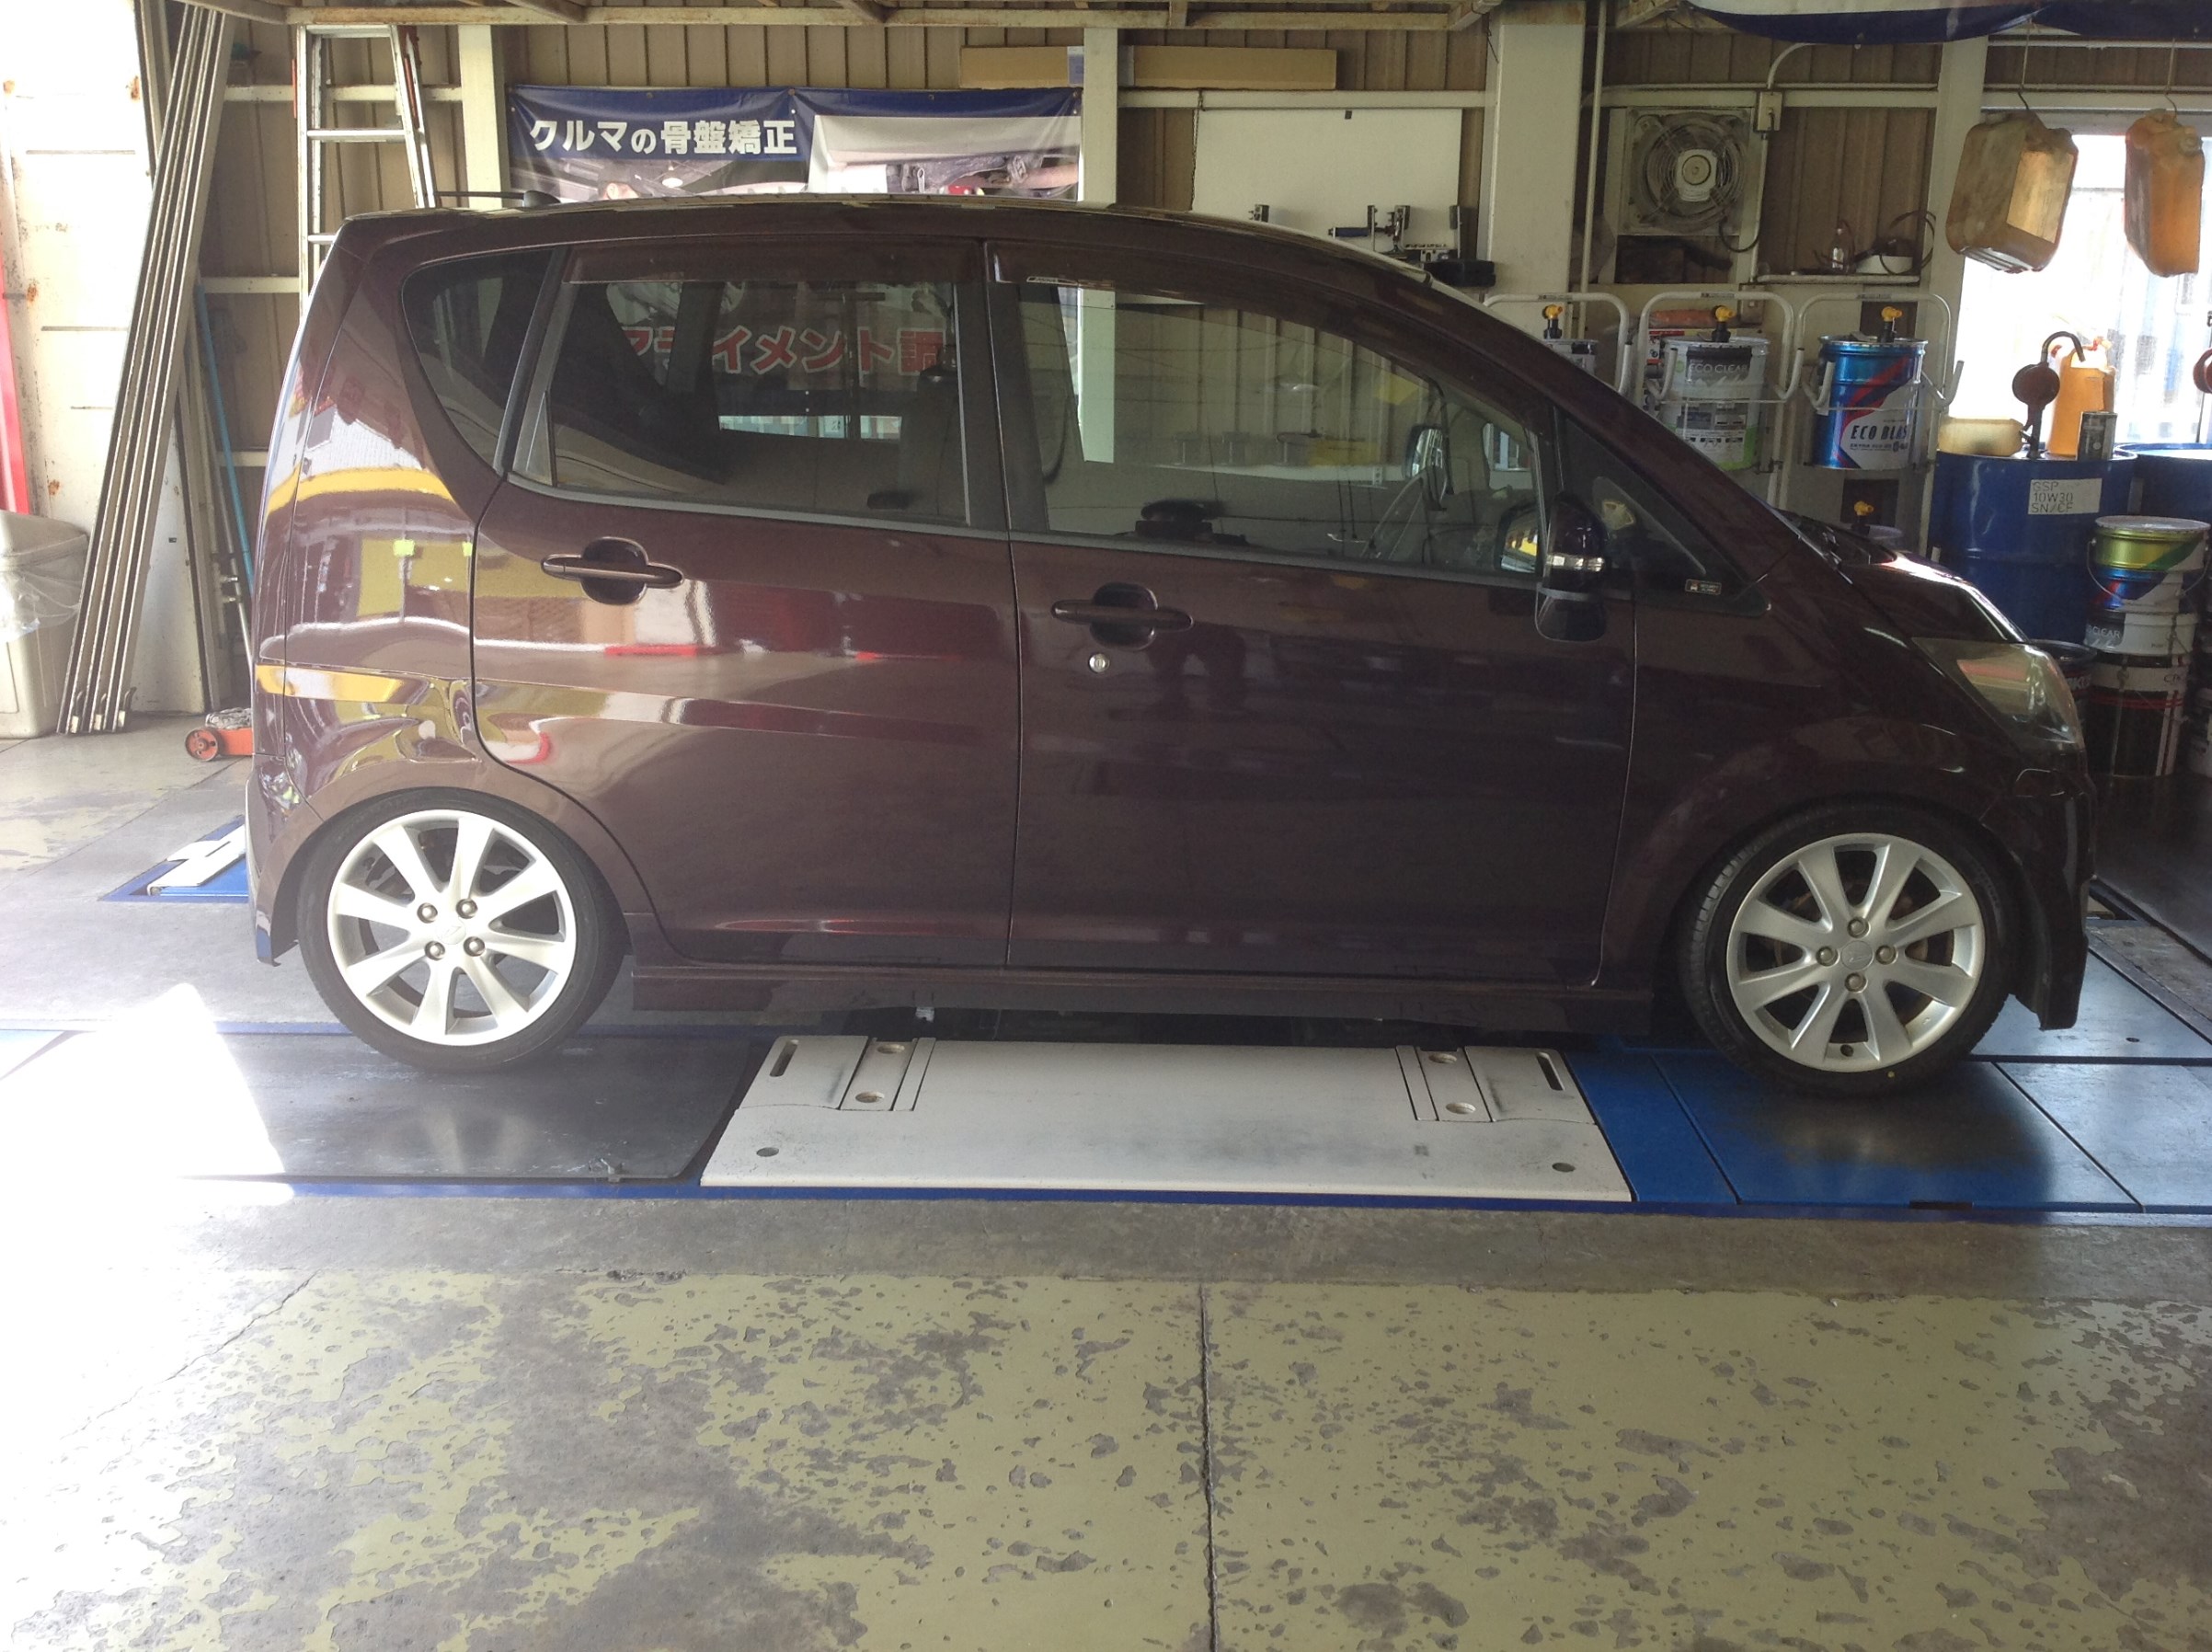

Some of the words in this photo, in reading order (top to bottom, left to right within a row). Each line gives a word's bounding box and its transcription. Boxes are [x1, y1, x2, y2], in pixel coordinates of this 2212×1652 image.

[530, 120, 797, 155] クルマの骨盤矯正
[1851, 425, 1877, 440] ECO
[2032, 480, 2059, 492] GSP
[2034, 492, 2074, 503] 10W30
[2031, 501, 2074, 513] SN/CF
